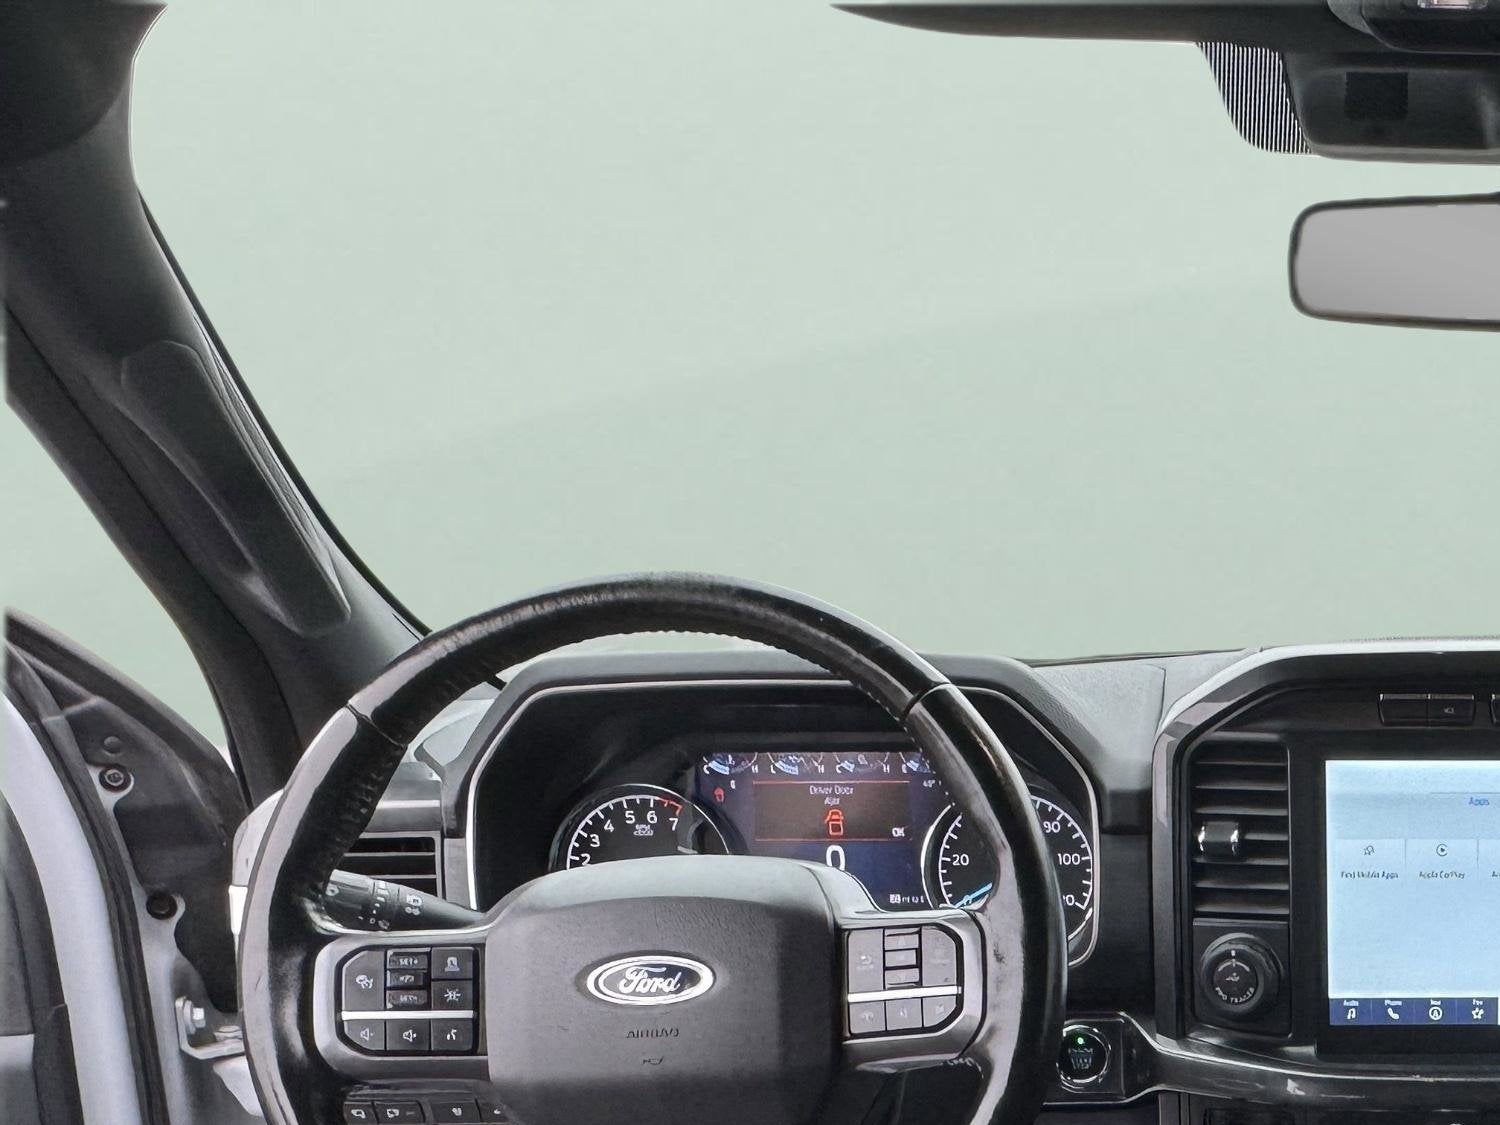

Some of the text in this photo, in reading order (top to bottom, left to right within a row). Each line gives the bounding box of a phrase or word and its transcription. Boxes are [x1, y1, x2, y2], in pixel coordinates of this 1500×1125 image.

[809, 785, 832, 795] Driver
[625, 810, 636, 824] 5
[646, 810, 658, 824] 6
[603, 819, 615, 832] 4
[669, 817, 679, 831] 7
[1043, 821, 1061, 833] 90
[590, 833, 600, 847] 3
[952, 853, 970, 866] 20
[1057, 853, 1081, 865] 100
[618, 966, 682, 993] Ford
